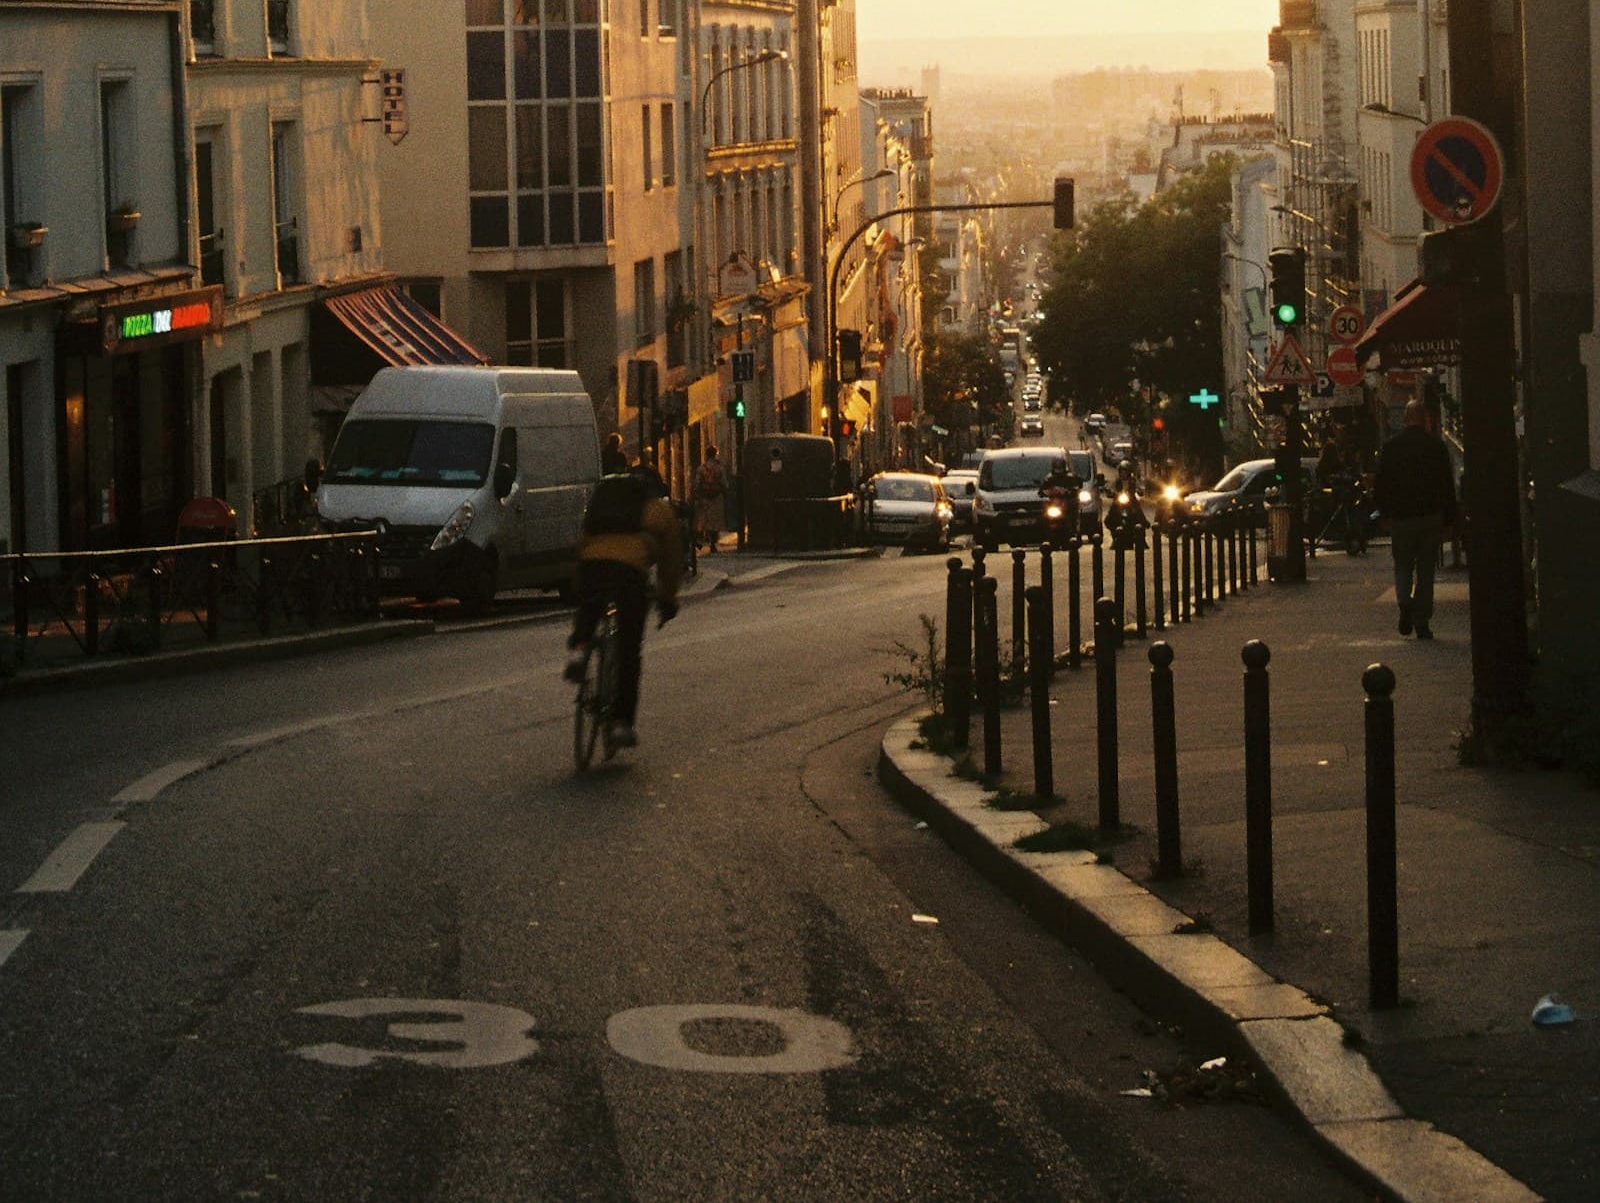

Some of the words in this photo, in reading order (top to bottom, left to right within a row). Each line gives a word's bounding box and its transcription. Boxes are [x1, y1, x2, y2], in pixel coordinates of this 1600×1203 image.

[383, 72, 403, 135] HOTEL
[1338, 317, 1358, 334] 30
[1317, 375, 1330, 394] P
[287, 997, 860, 1073] 30
